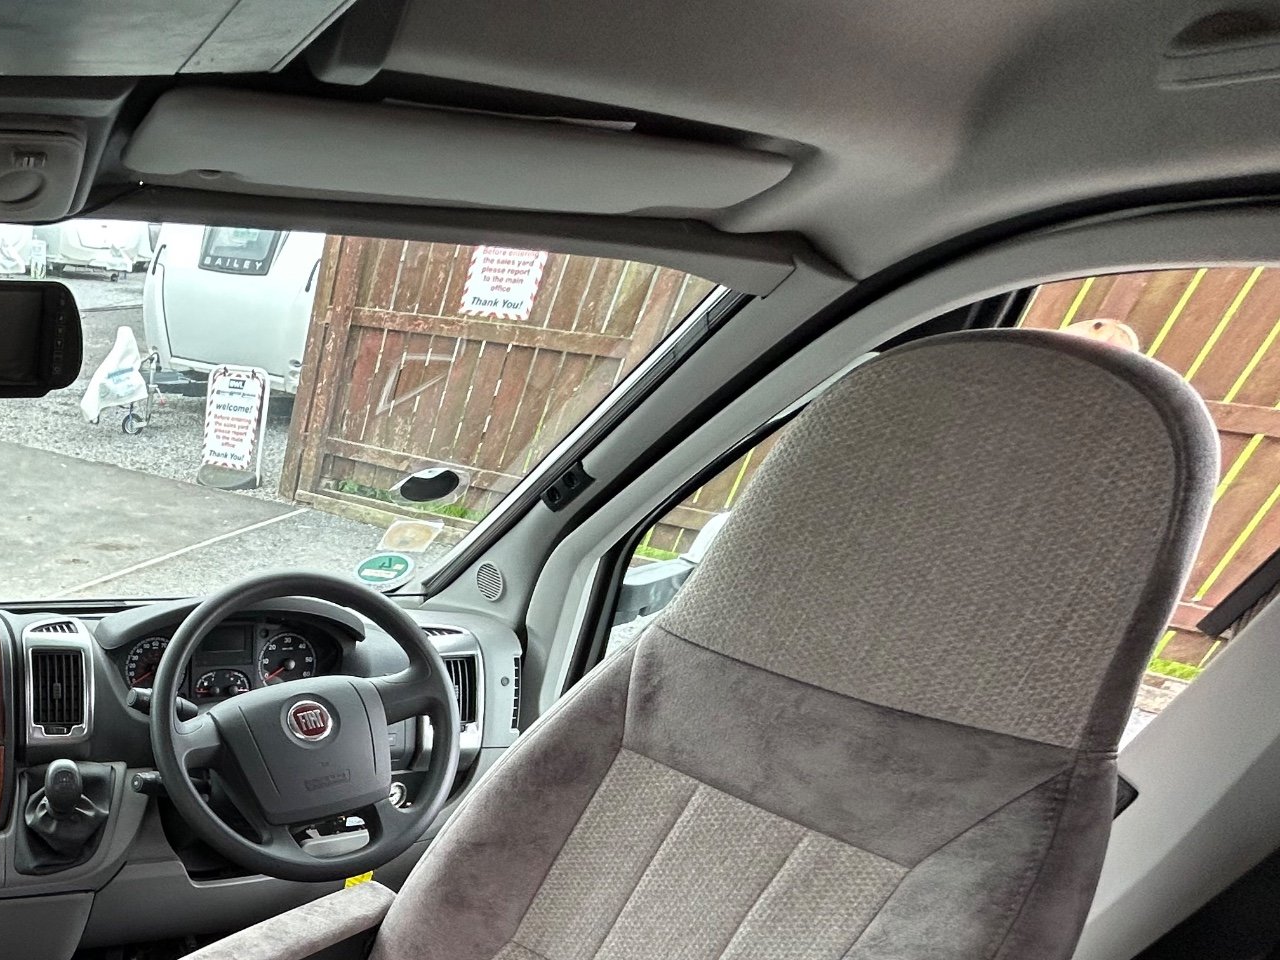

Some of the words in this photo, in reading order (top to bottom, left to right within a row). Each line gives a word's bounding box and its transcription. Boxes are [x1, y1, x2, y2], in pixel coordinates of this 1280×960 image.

[204, 256, 263, 270] BAILEY
[481, 266, 506, 274] please
[507, 268, 531, 276] report
[471, 296, 499, 307] Thank
[502, 299, 524, 309] You!
[215, 402, 253, 414] welcome!
[209, 449, 228, 459] Thank
[230, 452, 245, 461] You!
[297, 709, 324, 731] FIAT
